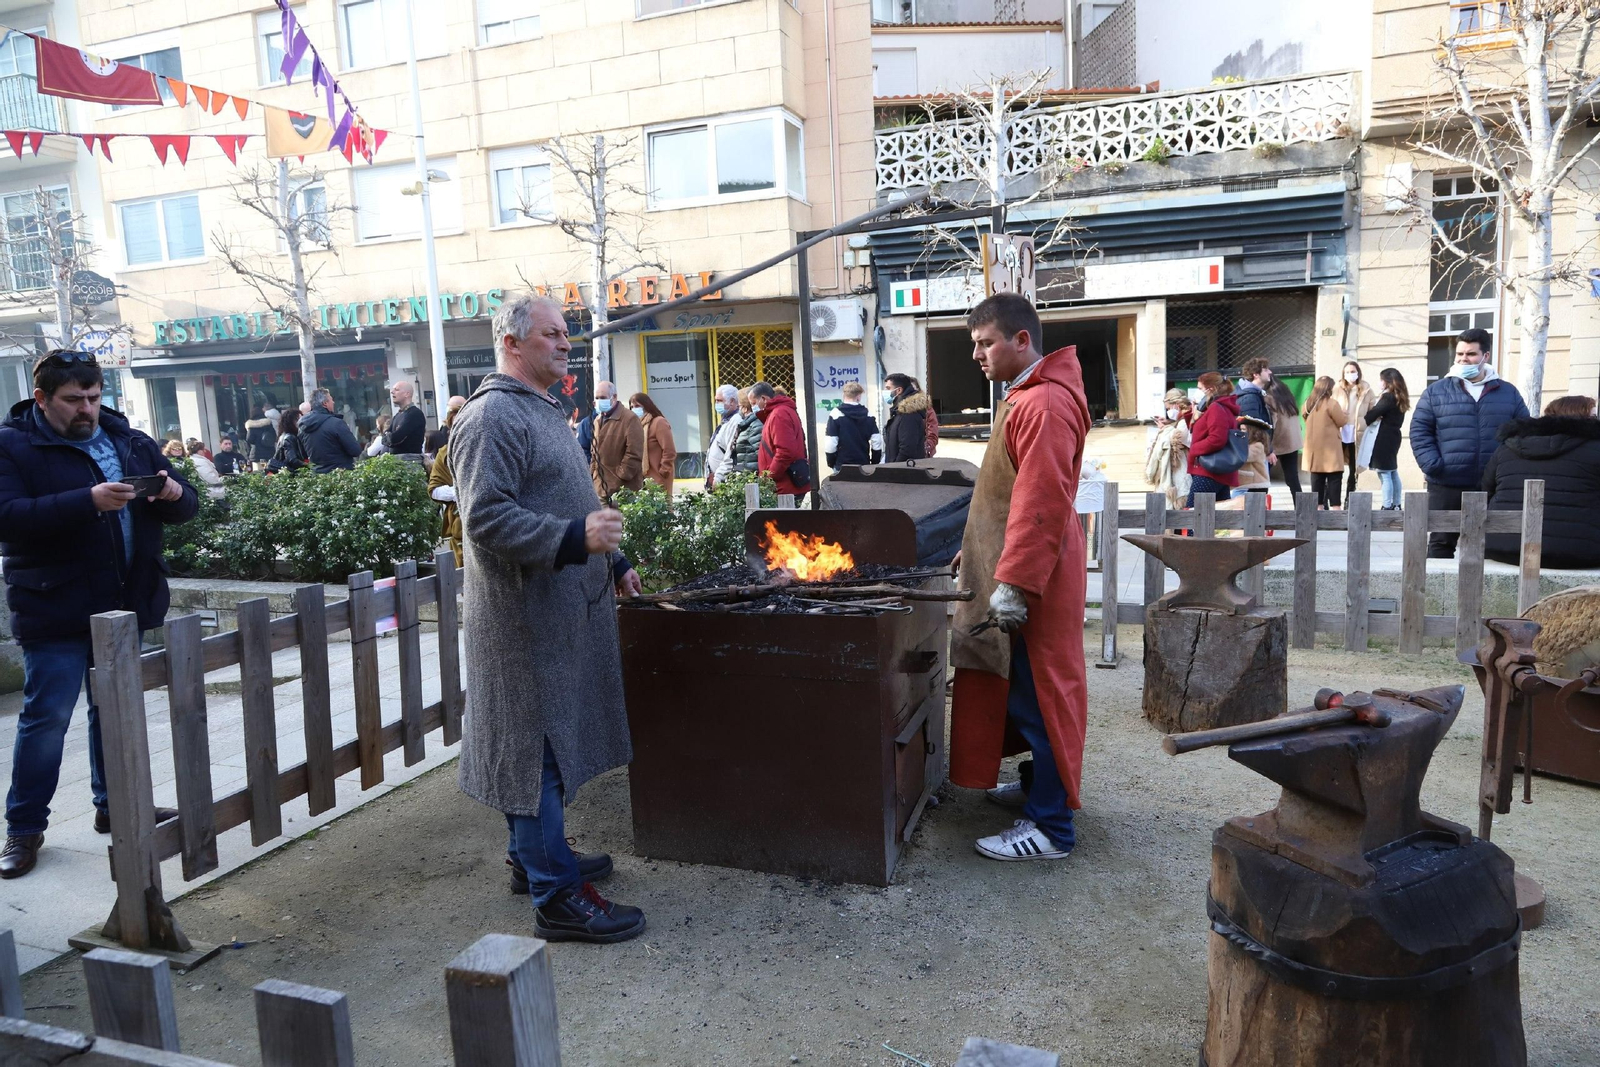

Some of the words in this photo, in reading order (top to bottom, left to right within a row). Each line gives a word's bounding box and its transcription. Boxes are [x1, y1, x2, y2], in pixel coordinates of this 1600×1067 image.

[606, 270, 722, 309] REAL
[673, 308, 735, 332] Sport
[674, 373, 695, 383] Sport
[829, 365, 859, 376] Dorna
